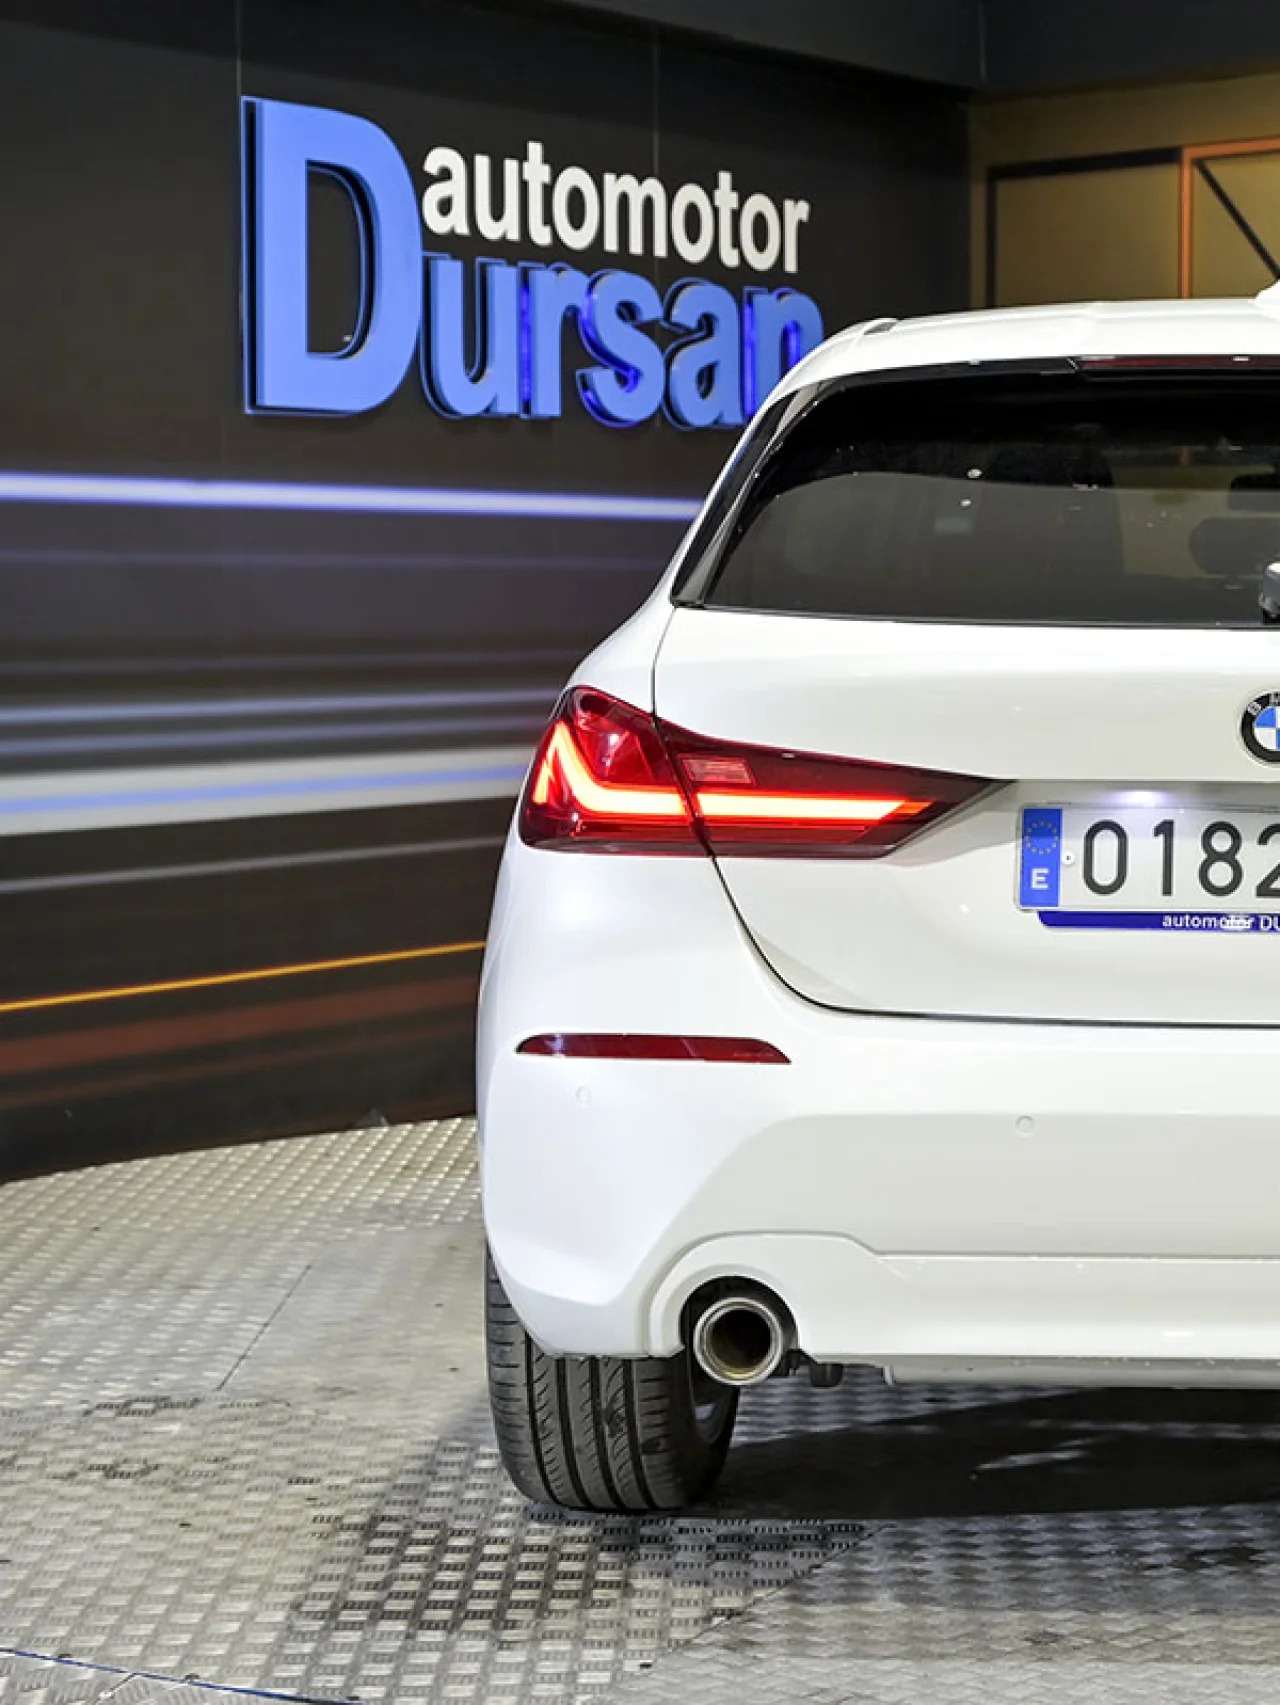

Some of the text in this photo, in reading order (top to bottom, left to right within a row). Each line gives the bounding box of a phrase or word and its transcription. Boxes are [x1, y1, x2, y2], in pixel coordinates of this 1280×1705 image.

[241, 95, 824, 430] Dursan
[421, 140, 810, 274] automotor
[1031, 867, 1049, 890] E
